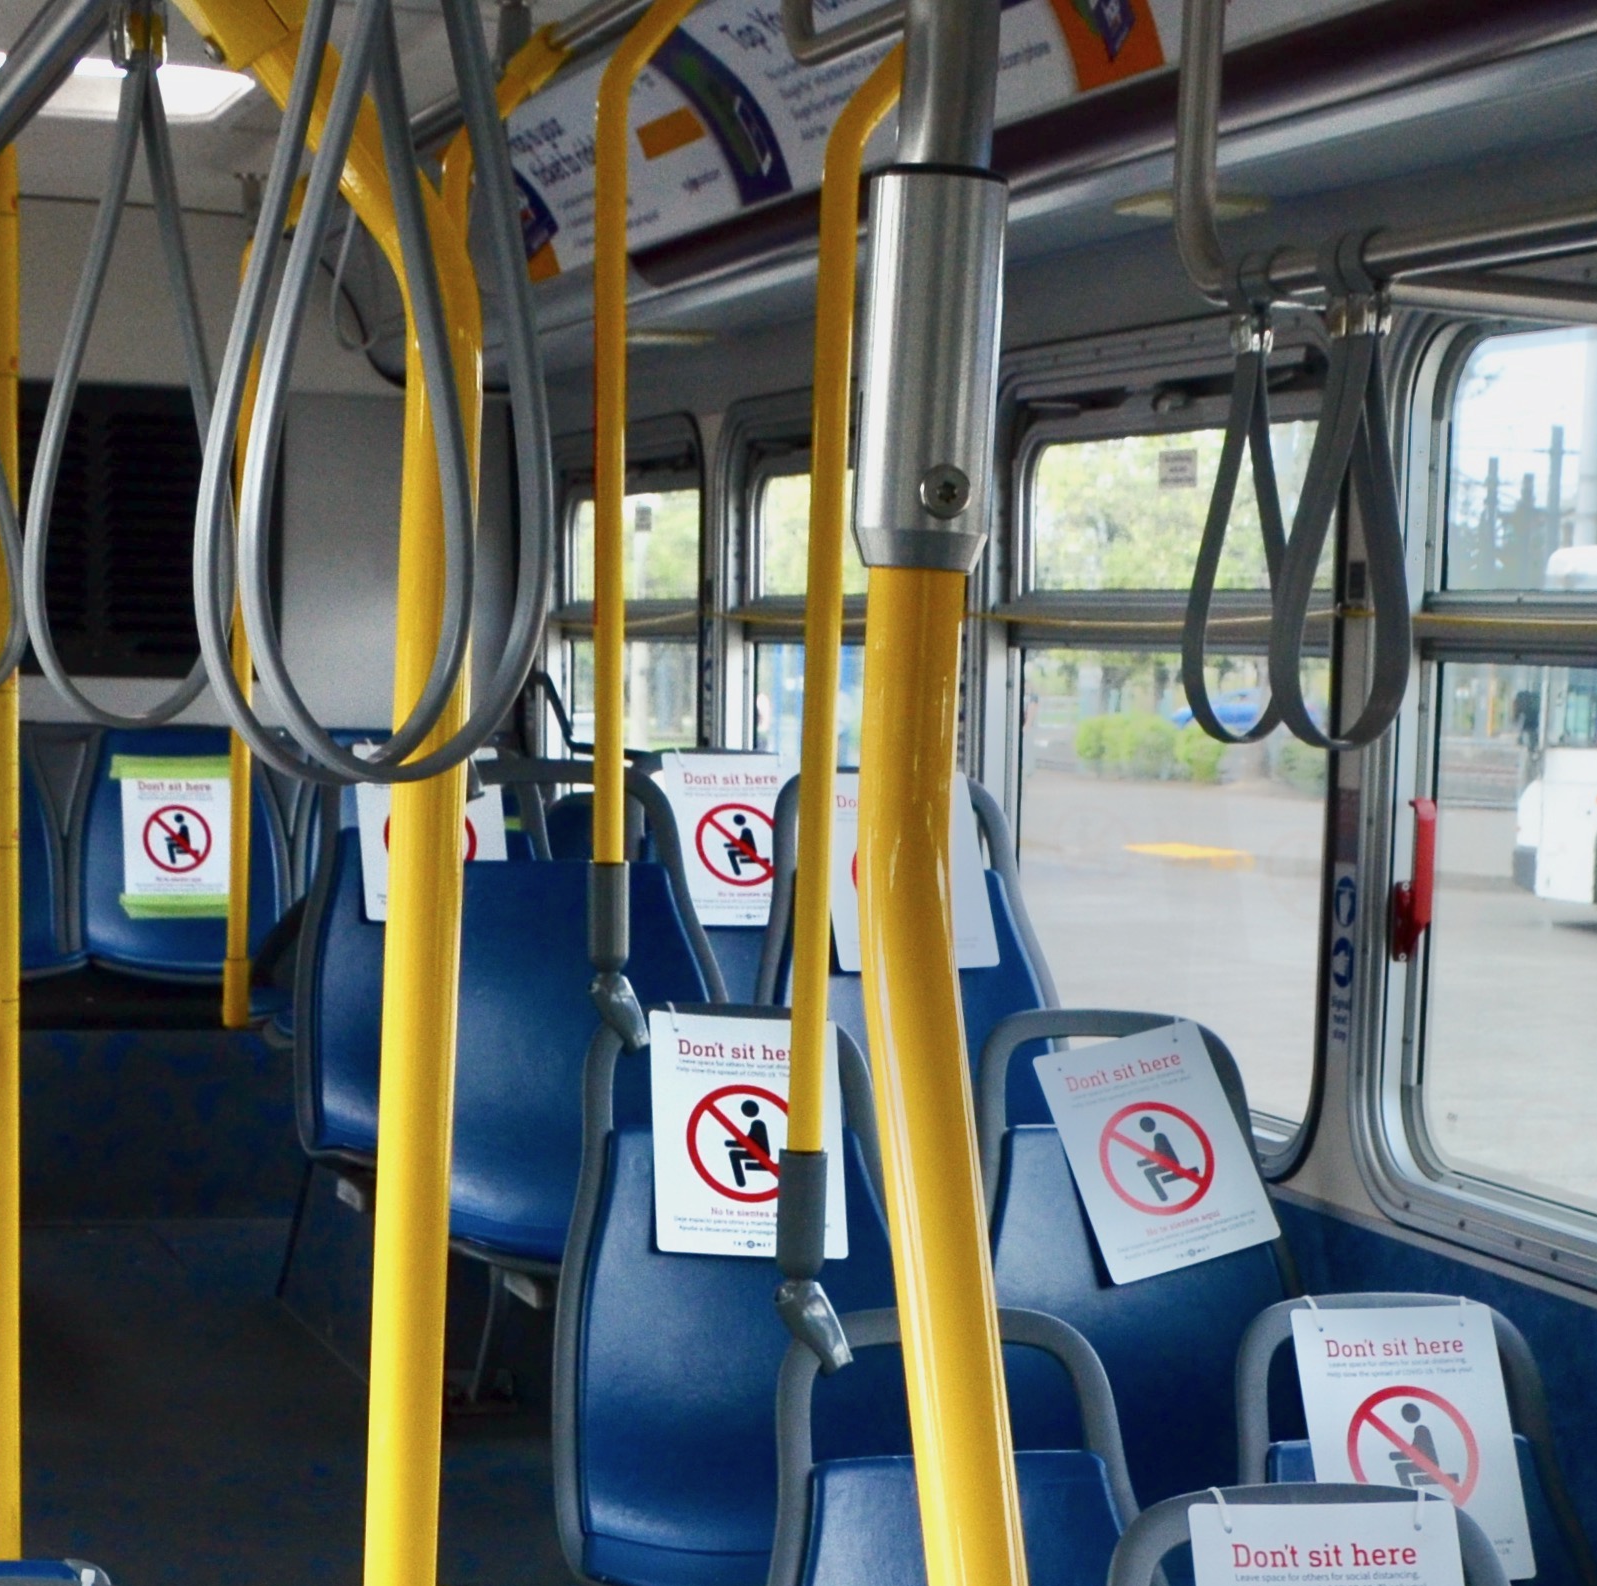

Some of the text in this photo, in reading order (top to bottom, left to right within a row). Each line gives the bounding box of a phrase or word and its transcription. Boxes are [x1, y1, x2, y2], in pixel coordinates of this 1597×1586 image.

[678, 1038, 791, 1061] Don't sit he
[1113, 1063, 1136, 1081] sit
[1138, 1053, 1181, 1074] here
[1323, 1336, 1464, 1359] Don't sit here
[1231, 1542, 1416, 1569] Don't sit here
